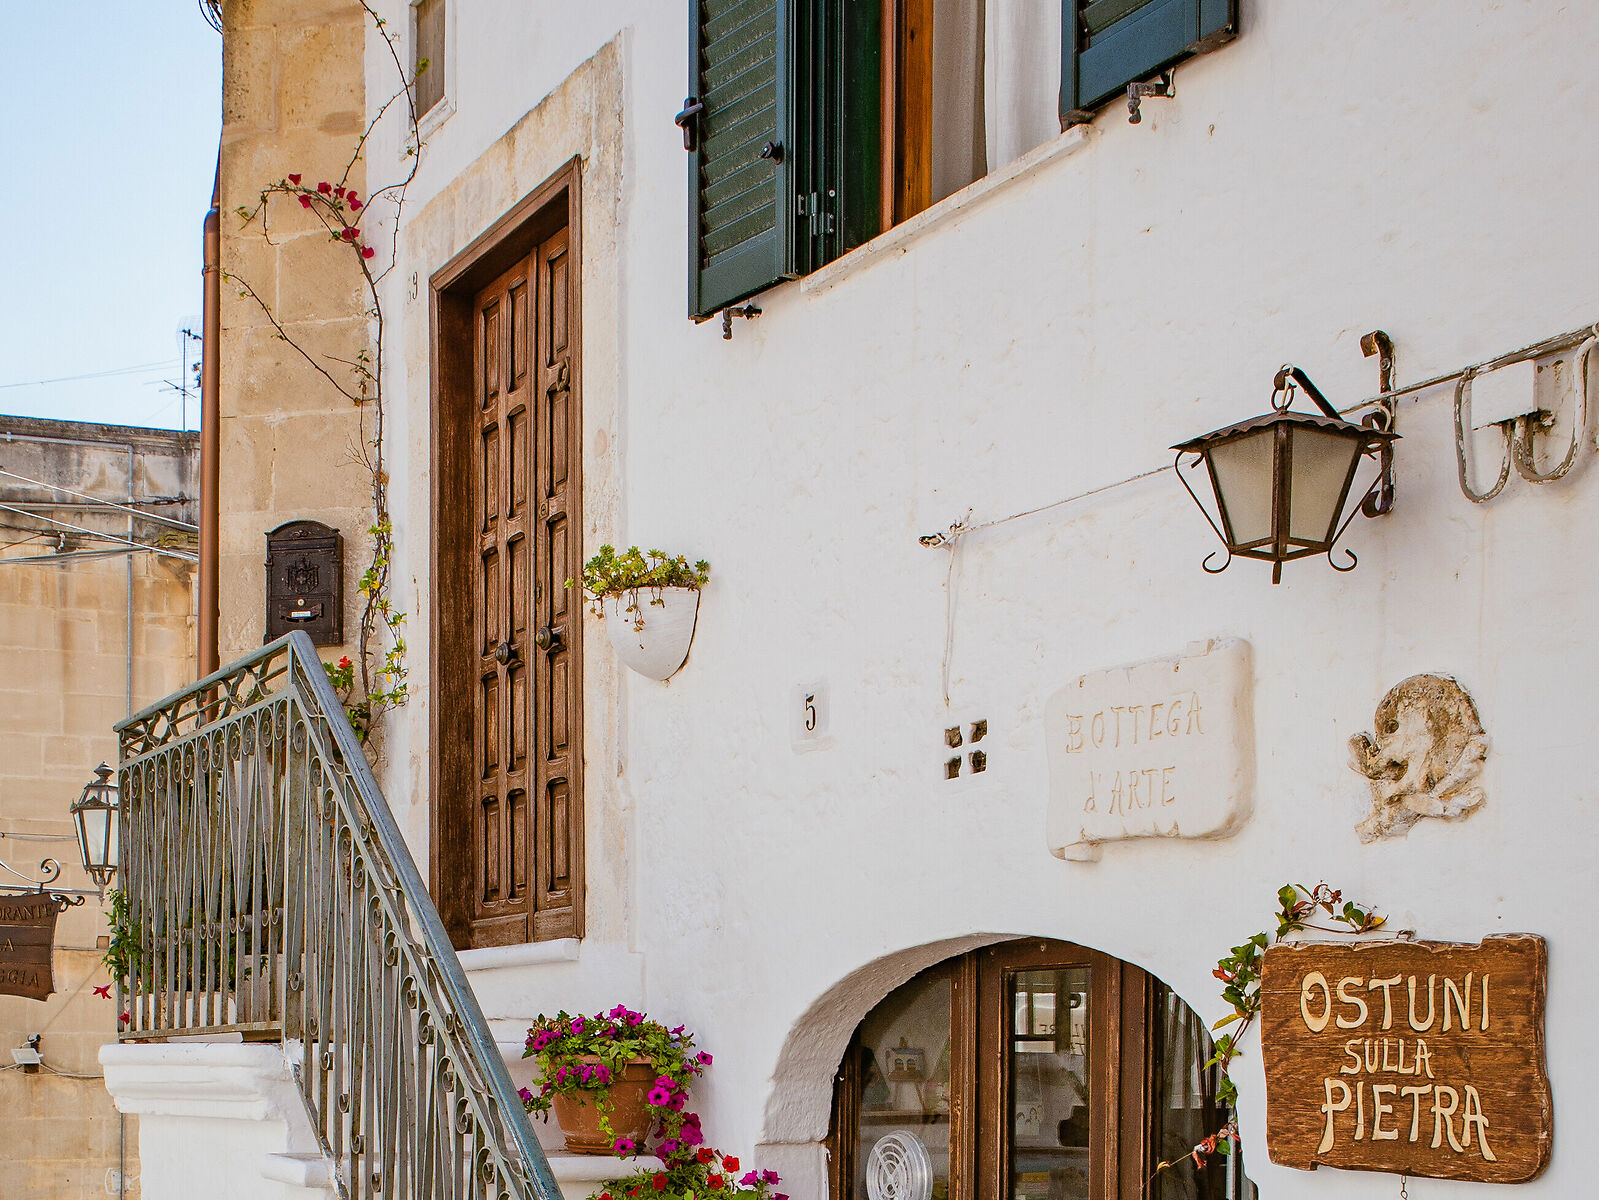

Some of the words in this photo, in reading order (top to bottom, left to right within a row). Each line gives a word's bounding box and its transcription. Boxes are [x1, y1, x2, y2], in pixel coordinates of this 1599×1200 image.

[805, 694, 816, 731] 5
[1065, 690, 1204, 754] BOTTEGA
[1300, 971, 1490, 1032] OSTUNI
[1340, 1038, 1435, 1079] SULLA
[1317, 1077, 1498, 1162] PIETRA
